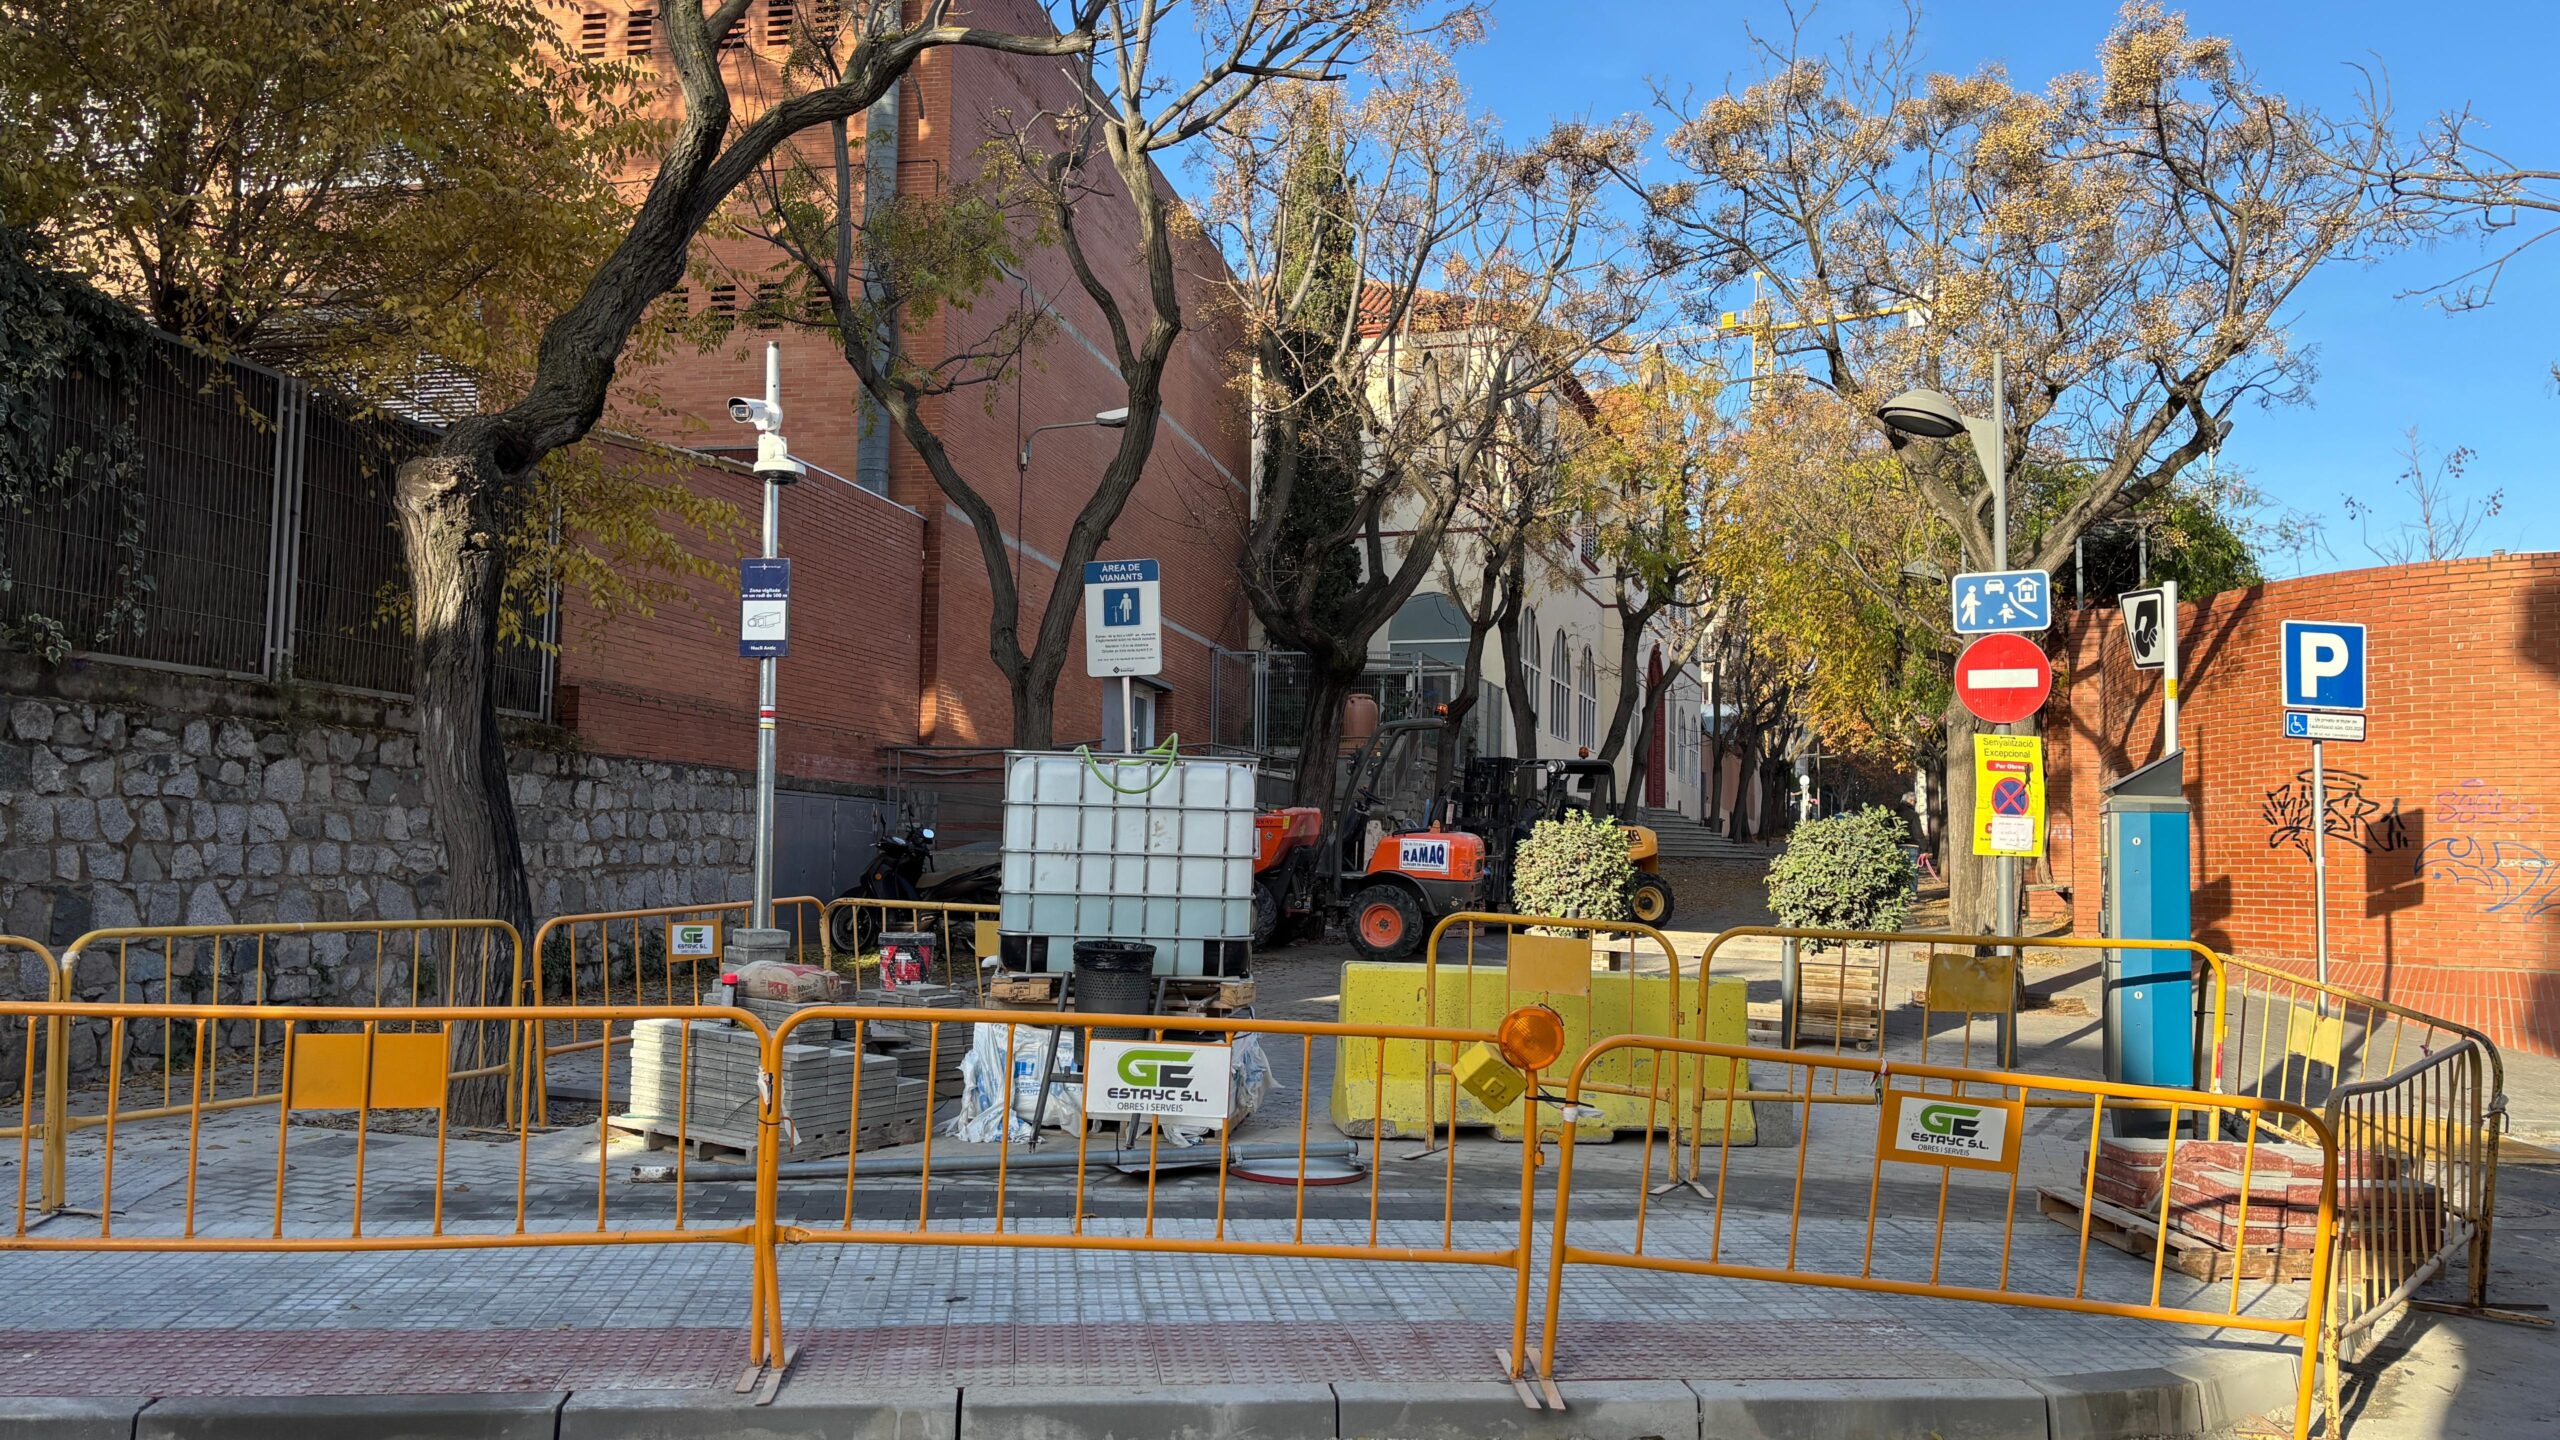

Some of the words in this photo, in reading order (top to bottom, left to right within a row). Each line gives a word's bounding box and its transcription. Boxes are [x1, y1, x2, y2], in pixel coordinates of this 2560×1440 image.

[1128, 563, 1140, 572] DE
[1099, 573, 1143, 582] VIANANTS
[2301, 632, 2349, 698] P
[1983, 737, 2033, 748] Senyalització
[1984, 748, 2031, 759] Excepcional
[1403, 844, 1445, 865] RAMAQ
[1117, 1049, 1195, 1088] GE
[1107, 1087, 1176, 1101] ESTAYC
[1181, 1090, 1208, 1102] S.L.
[1117, 1102, 1144, 1111] OBRES
[1151, 1103, 1183, 1112] SERVEIS
[1920, 1104, 1982, 1138] GE
[1911, 1132, 1965, 1147] ESTAYC
[1968, 1139, 1989, 1150] S.L.
[1918, 1143, 1939, 1153] OBRES
[1944, 1147, 1970, 1157] SERVEIS
